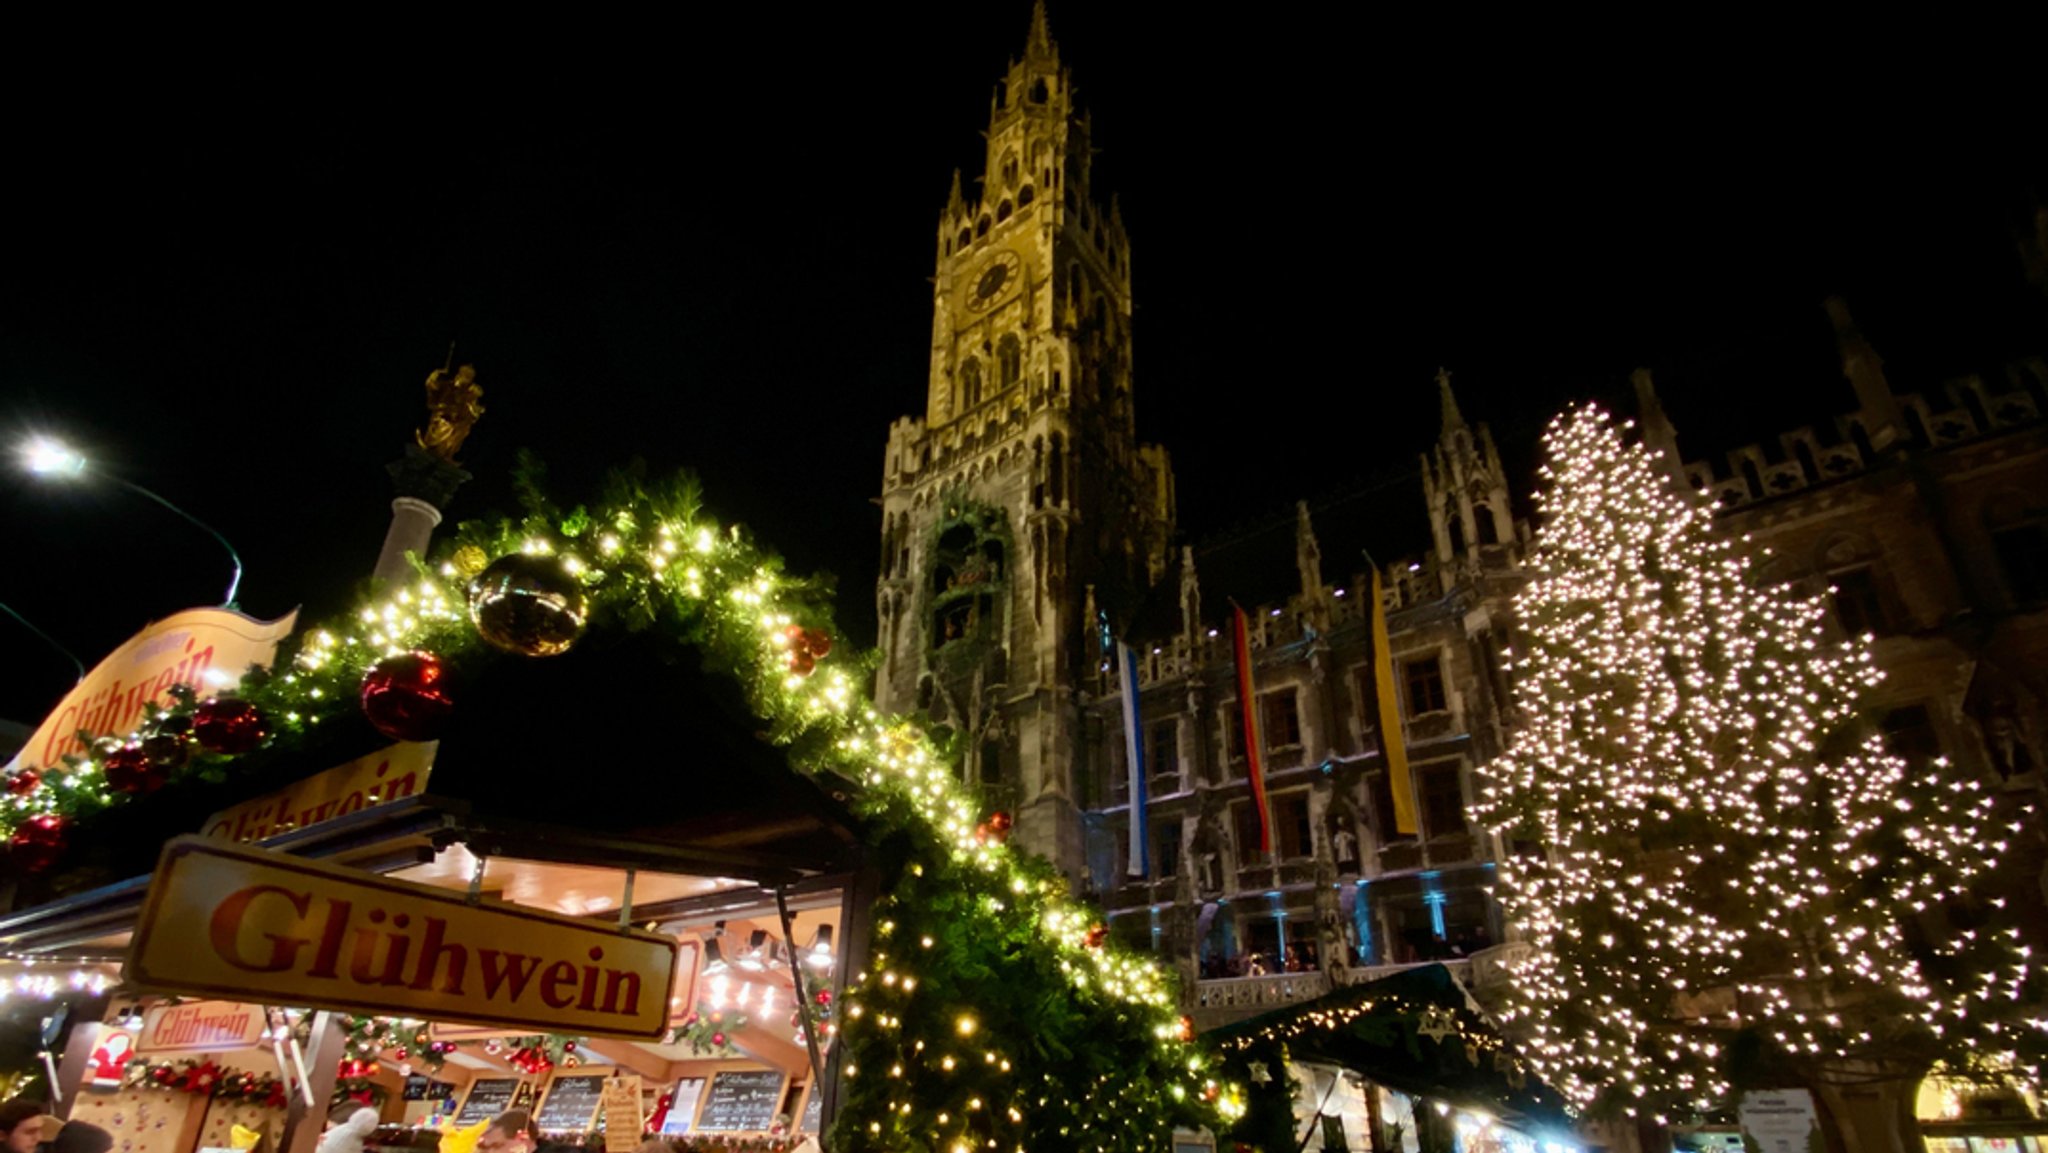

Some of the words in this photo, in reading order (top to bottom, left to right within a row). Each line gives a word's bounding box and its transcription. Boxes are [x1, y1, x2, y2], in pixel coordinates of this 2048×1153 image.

[43, 638, 213, 768] Glühwein
[209, 884, 640, 1017] Glühwein
[153, 1004, 250, 1046] Glühwein
